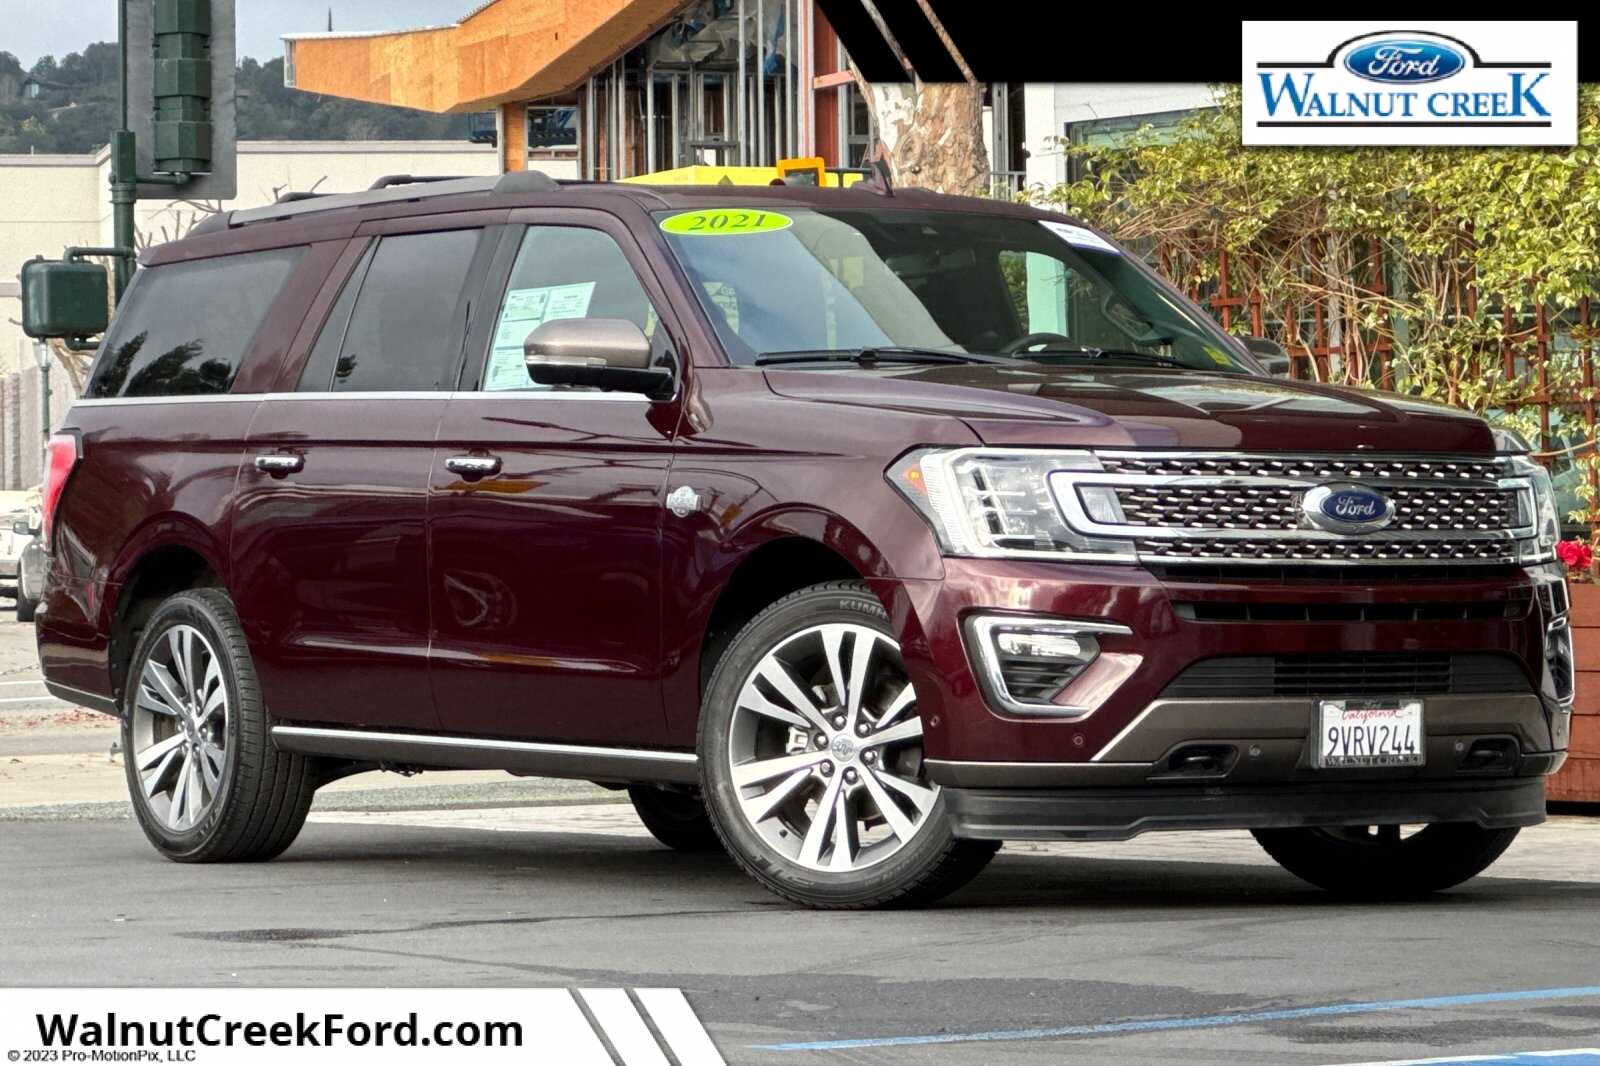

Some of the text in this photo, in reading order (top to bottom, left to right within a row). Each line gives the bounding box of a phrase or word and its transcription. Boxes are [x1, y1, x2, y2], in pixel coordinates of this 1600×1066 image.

[687, 214, 768, 231] 2021
[1335, 496, 1376, 516] Ford
[840, 599, 889, 618] KUMH
[1327, 725, 1415, 756] 9VRV244
